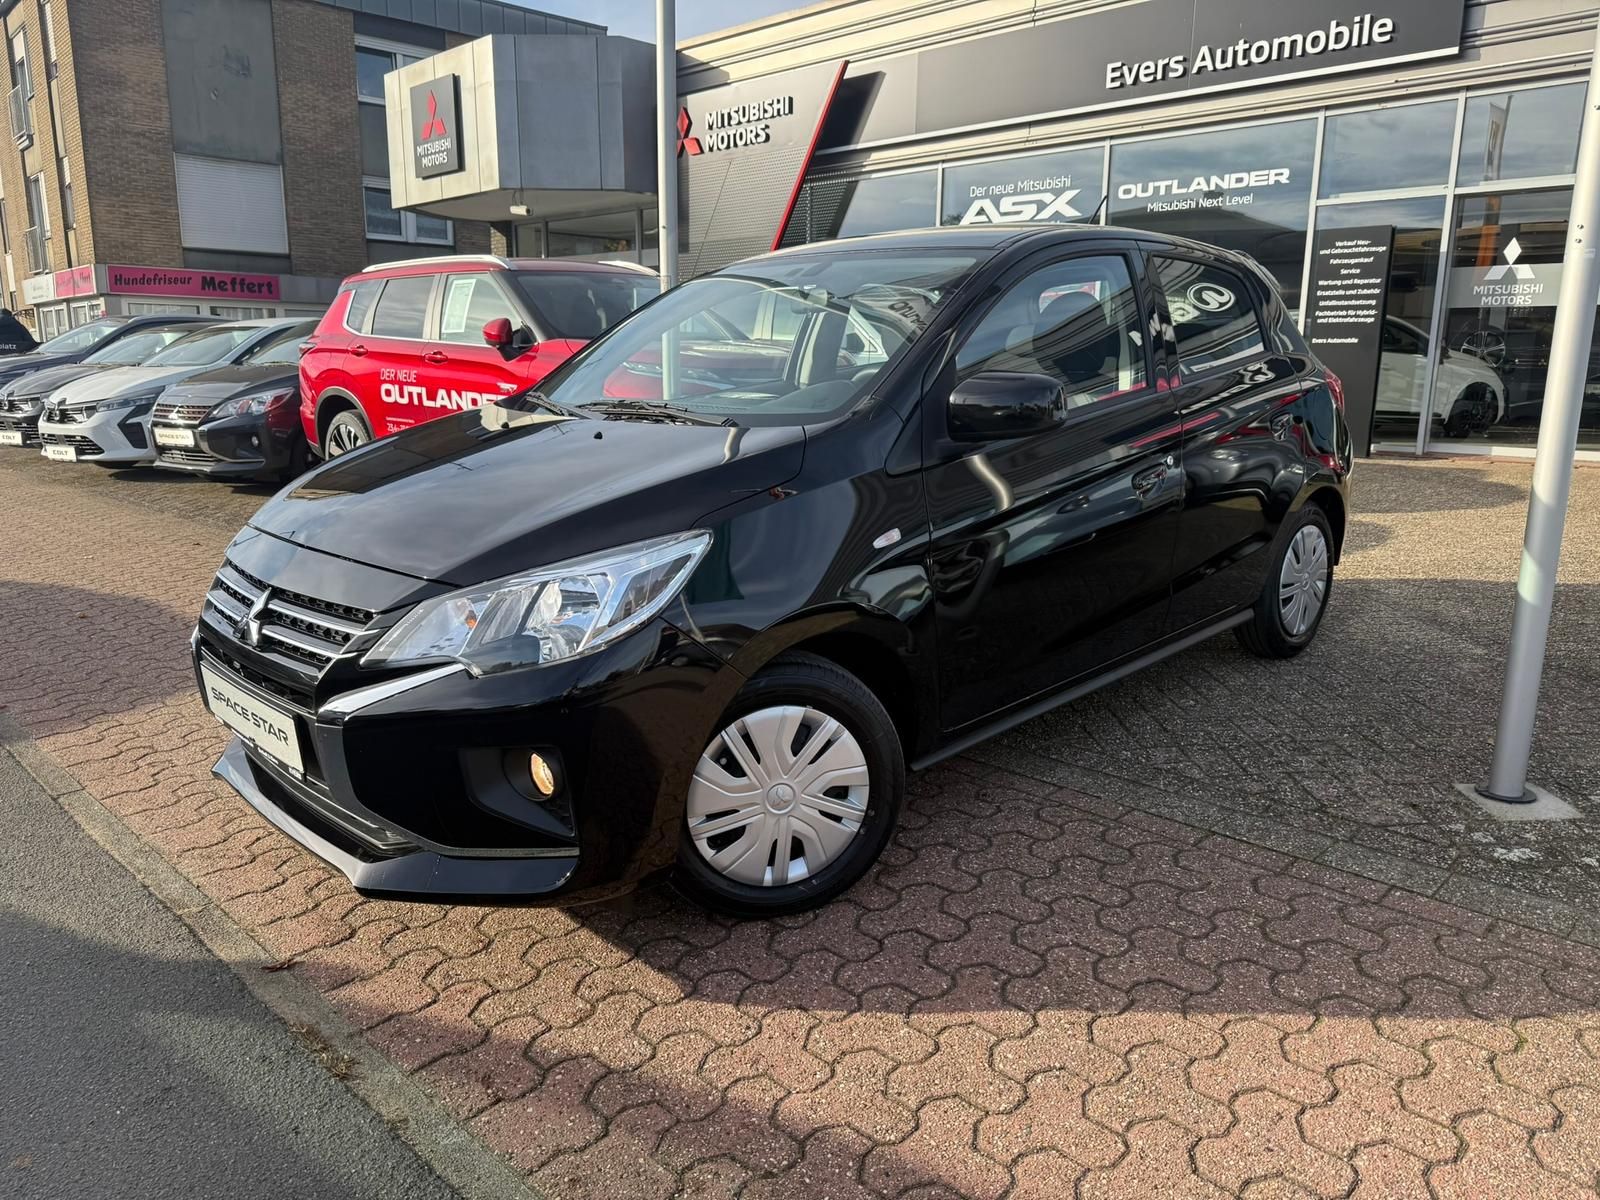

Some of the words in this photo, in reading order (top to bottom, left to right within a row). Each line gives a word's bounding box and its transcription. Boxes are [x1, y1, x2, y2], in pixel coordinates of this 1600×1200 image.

[1105, 54, 1185, 89] Evers
[1191, 13, 1394, 75] Automobile
[705, 96, 791, 130] MITSUBISHI
[416, 137, 452, 157] MITSUBISHI
[705, 124, 768, 152] MOTORS
[422, 152, 448, 168] MOTORS
[969, 186, 987, 197] Der
[989, 183, 1015, 196] neue
[1017, 174, 1072, 192] Mitsubishi
[1117, 168, 1290, 199] OUTLANDER
[958, 188, 1083, 226] ASX
[1147, 198, 1196, 213] Mitsubishi
[1198, 197, 1224, 208] Next
[1226, 193, 1254, 206] Level
[1331, 246, 1387, 254] Gebrauchtfahrzeuge
[114, 273, 192, 286] Hundefriseur
[200, 275, 274, 295] Meffert
[1473, 283, 1544, 295] MITSUBISHI
[1481, 295, 1532, 305] MOTORS
[380, 368, 395, 381] DER
[397, 369, 418, 383] NEUE
[380, 383, 509, 411] OUTLANDE
[211, 686, 251, 722] SPACE
[251, 711, 289, 746] STAR
